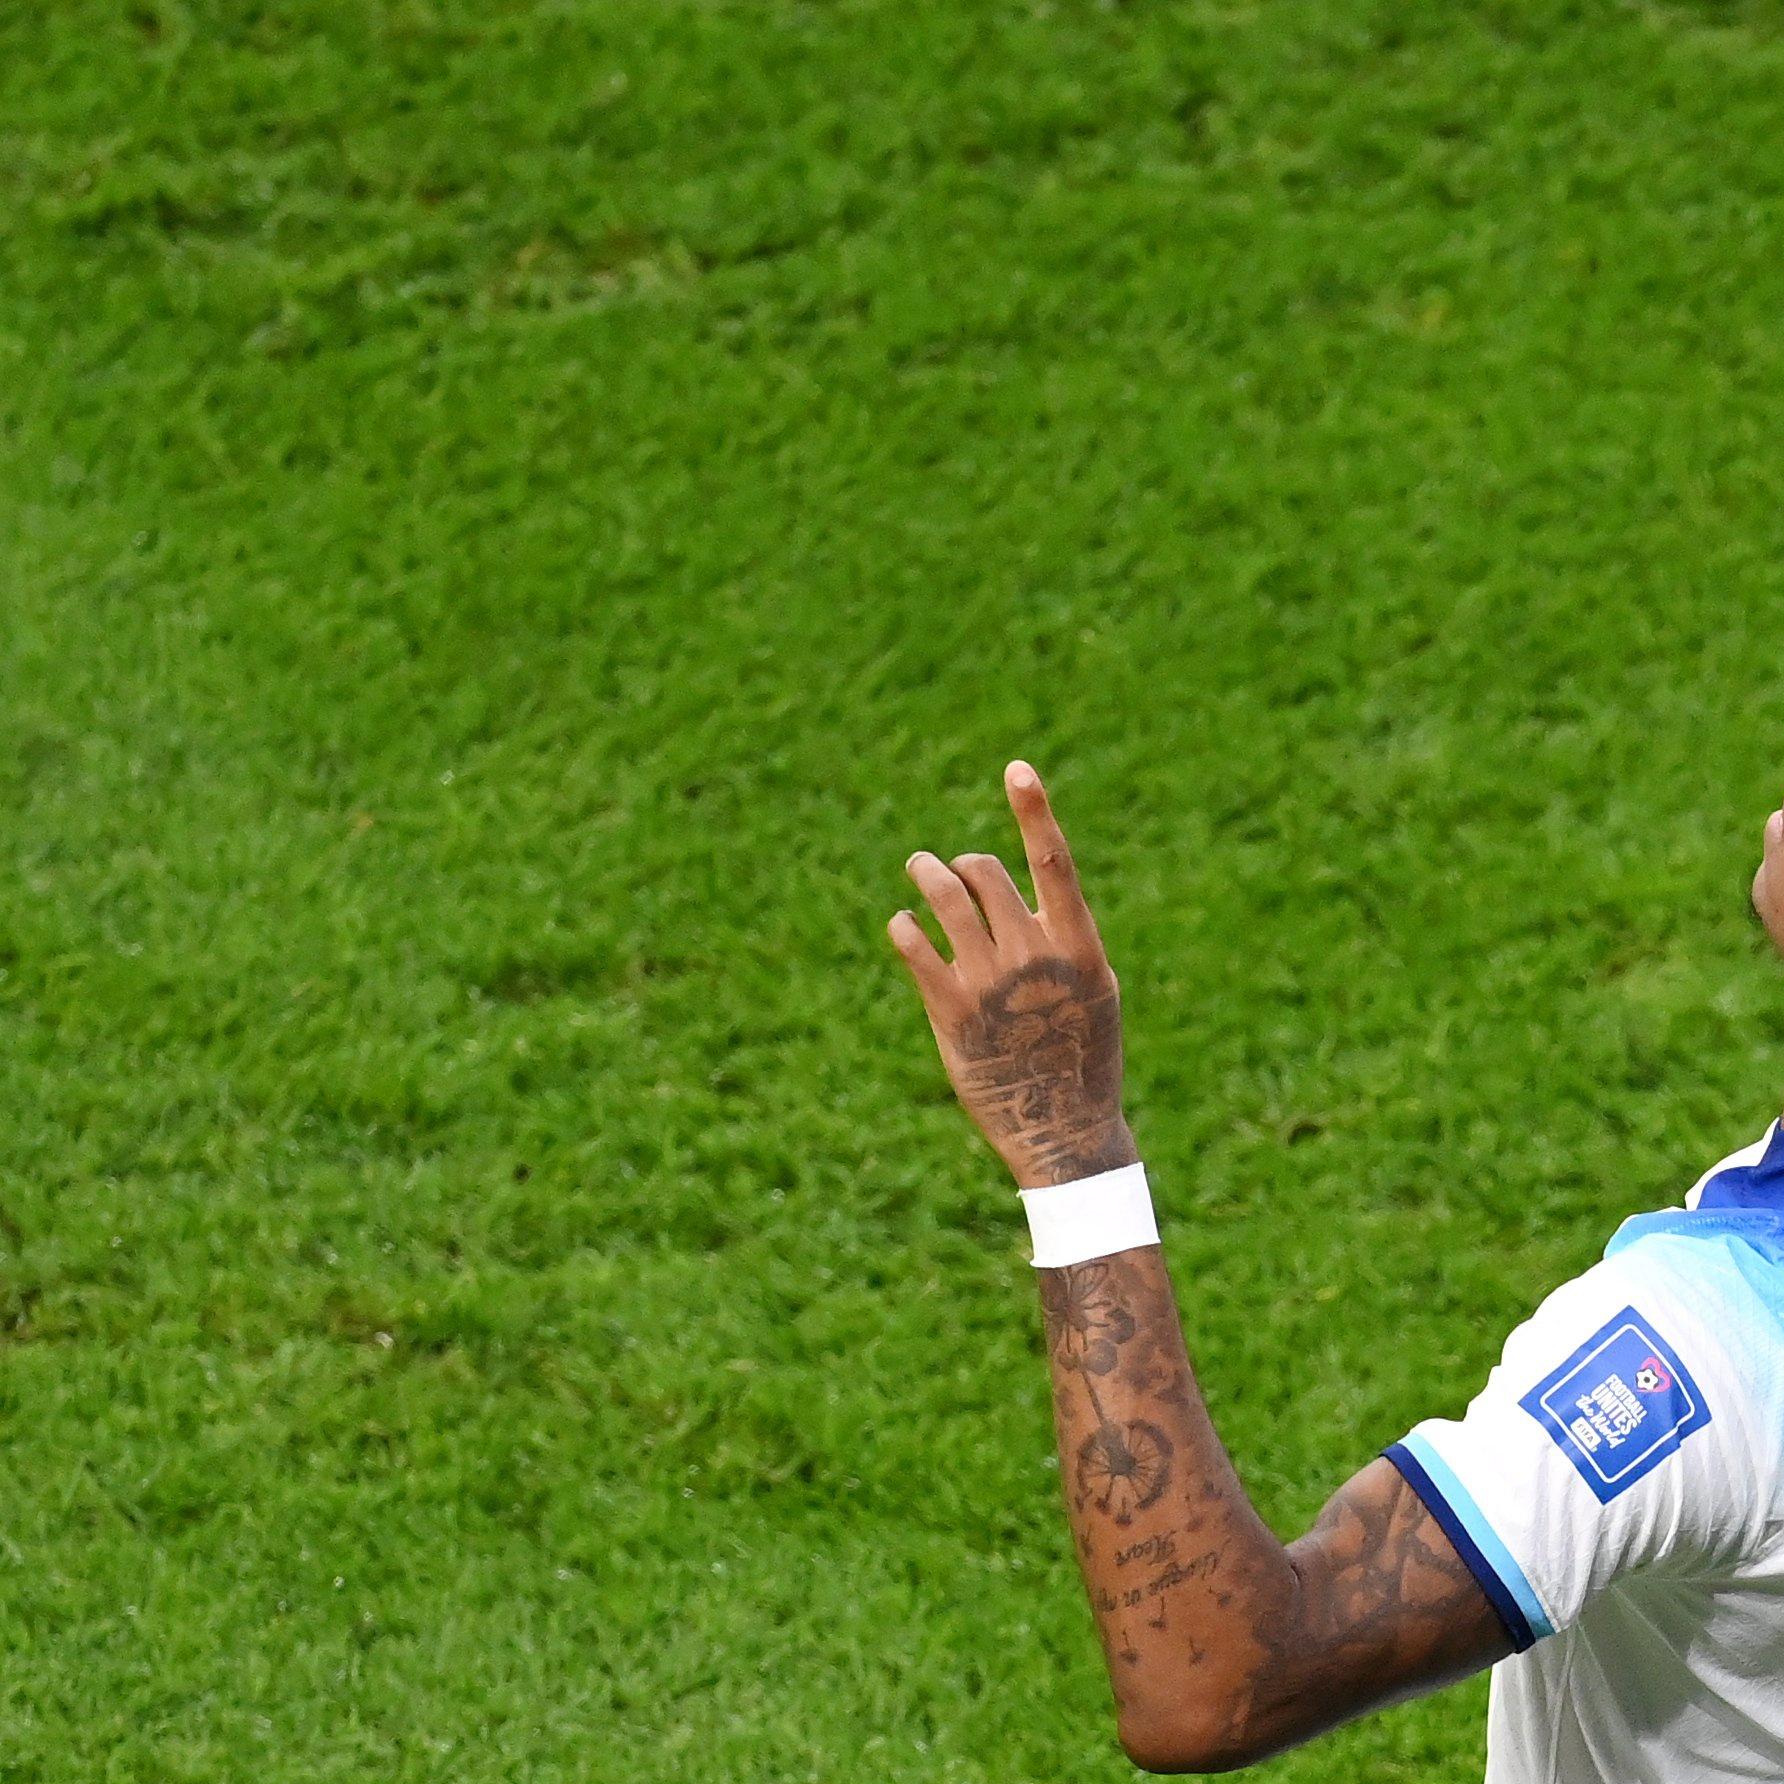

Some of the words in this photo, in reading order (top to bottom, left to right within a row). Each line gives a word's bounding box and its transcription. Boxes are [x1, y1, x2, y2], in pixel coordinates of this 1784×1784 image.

[1575, 1393, 1594, 1417] the
[1591, 1383, 1637, 1435] UNITES
[1605, 1373, 1648, 1423] FOOTBALL
[1576, 1422, 1594, 1443] FIFA
